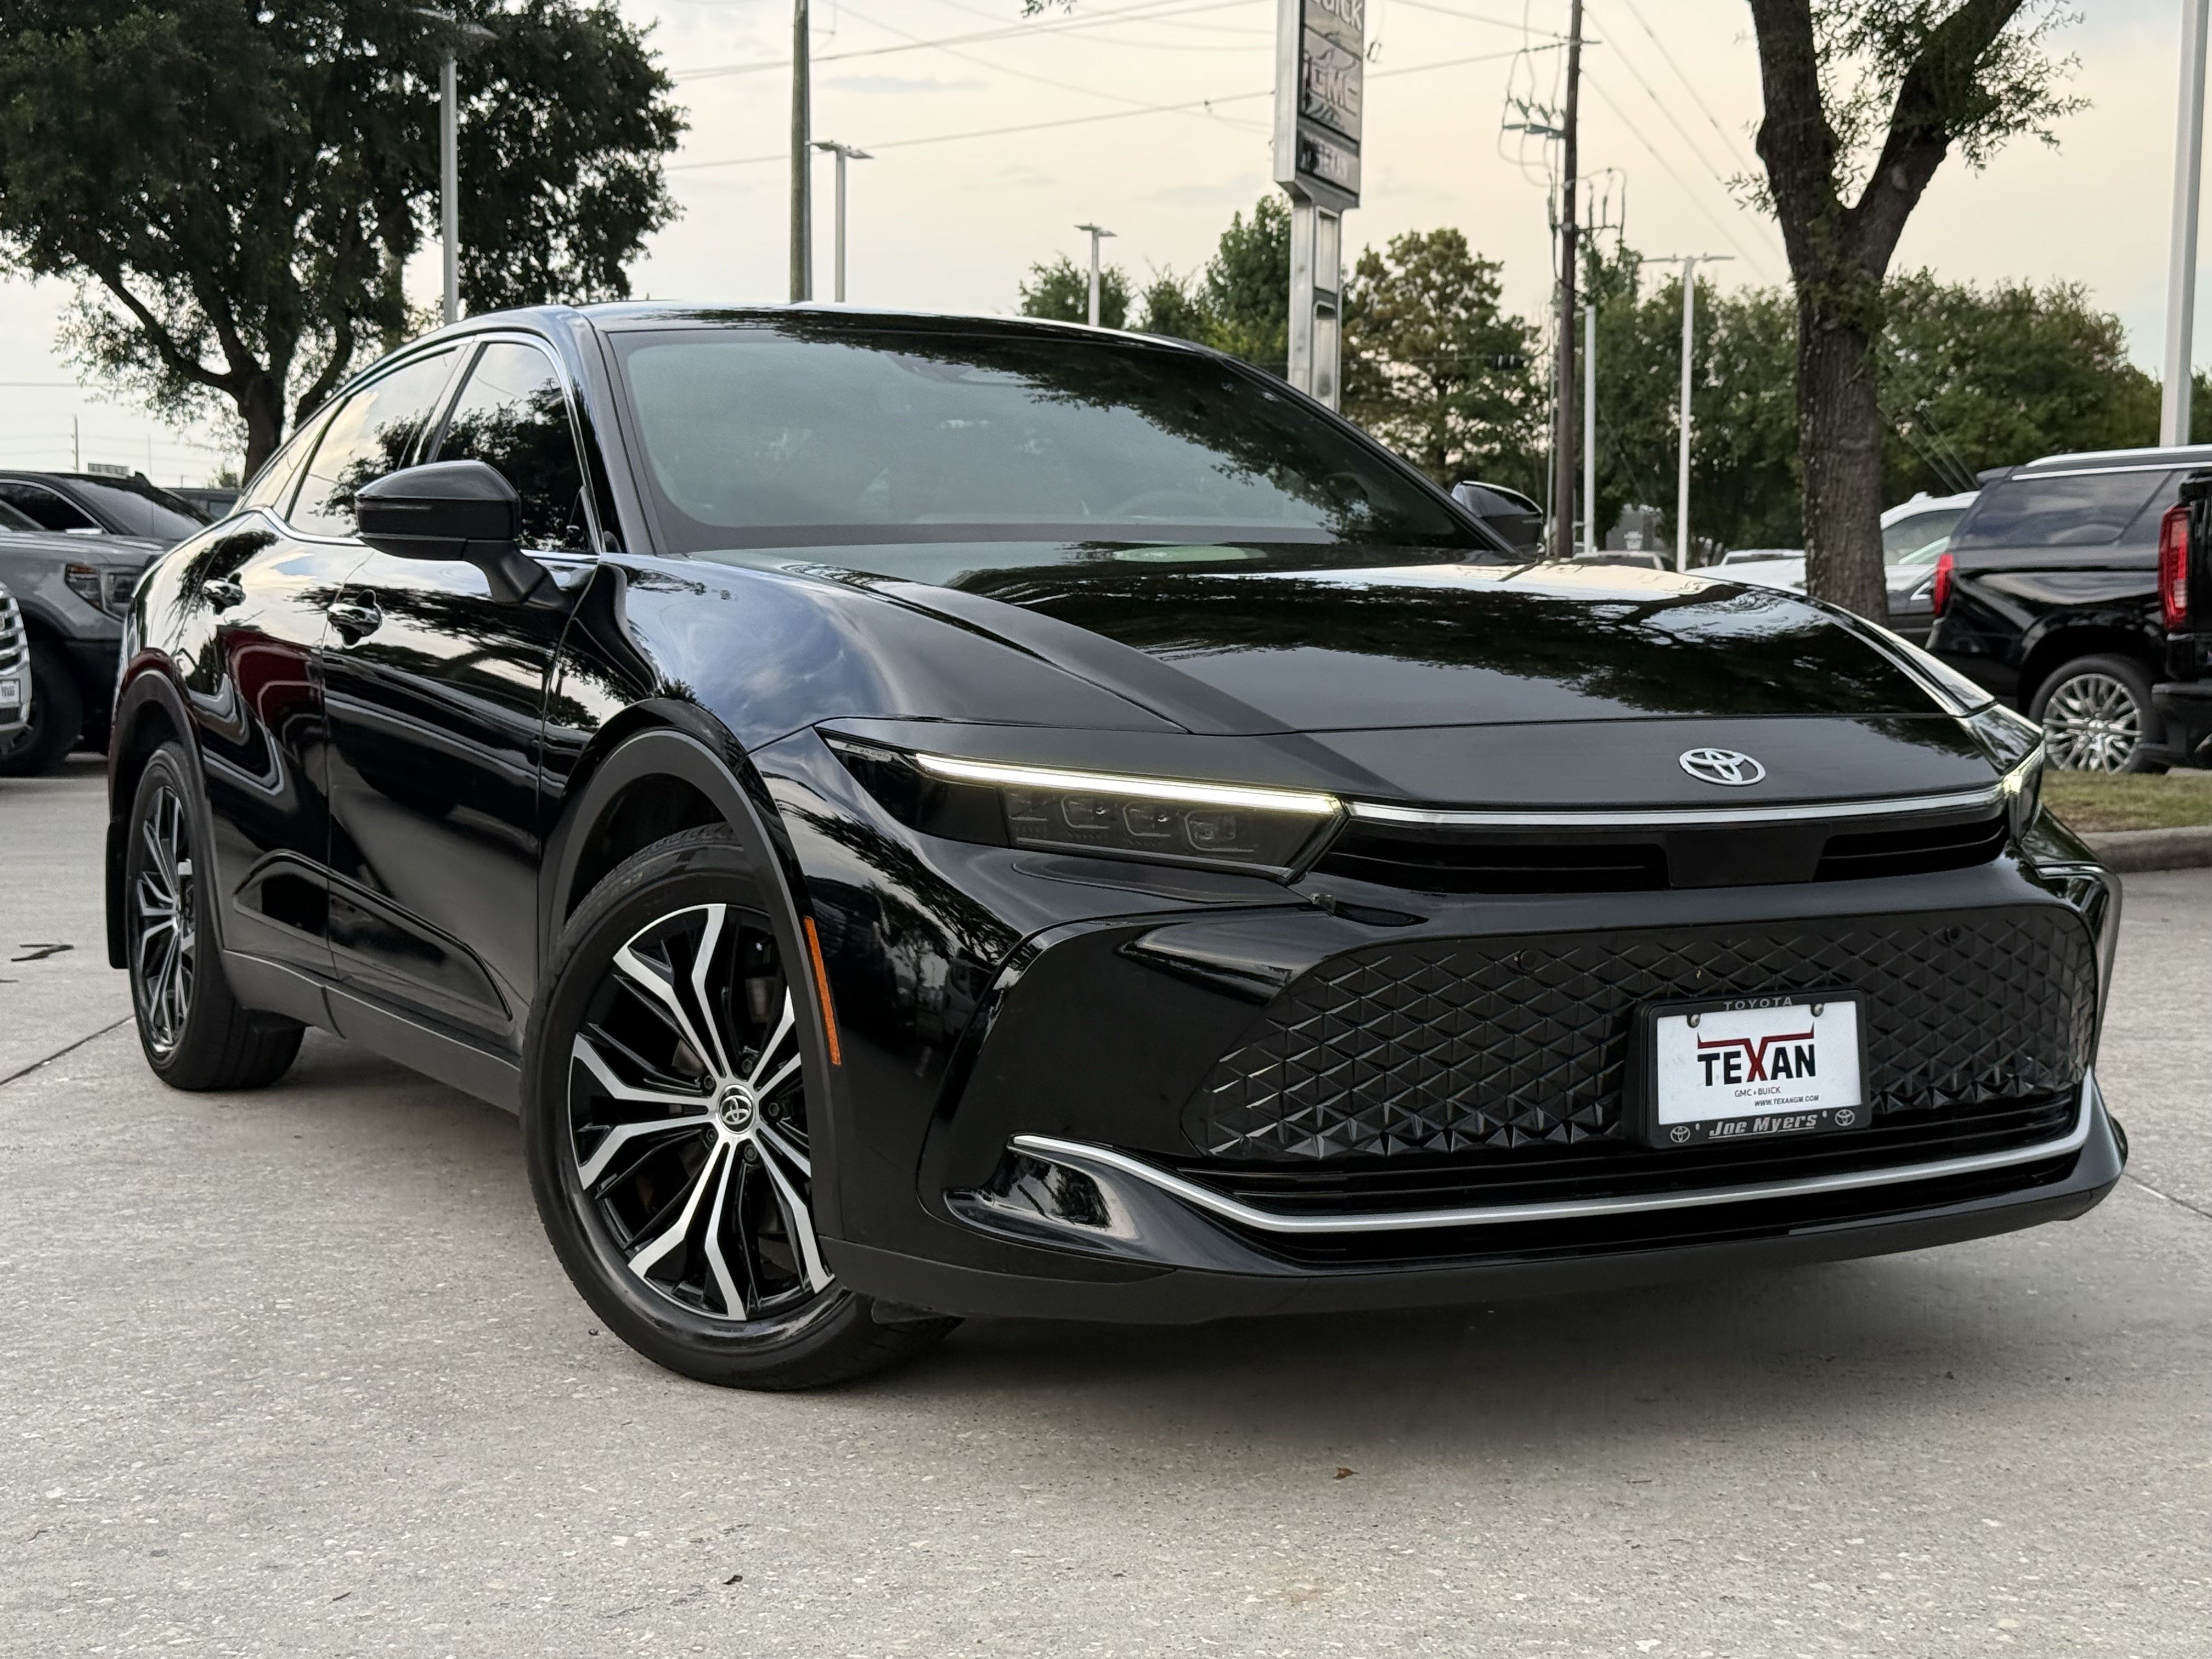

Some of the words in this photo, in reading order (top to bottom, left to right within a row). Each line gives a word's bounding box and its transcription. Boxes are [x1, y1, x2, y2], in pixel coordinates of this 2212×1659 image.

[1723, 996, 1793, 1011] TOYOTA
[1697, 1036, 1816, 1087] TEXAN
[1734, 1088, 1752, 1097] GMC
[1758, 1086, 1781, 1096] BUICK
[1709, 1120, 1747, 1137] Joe
[1753, 1113, 1818, 1133] Myers
